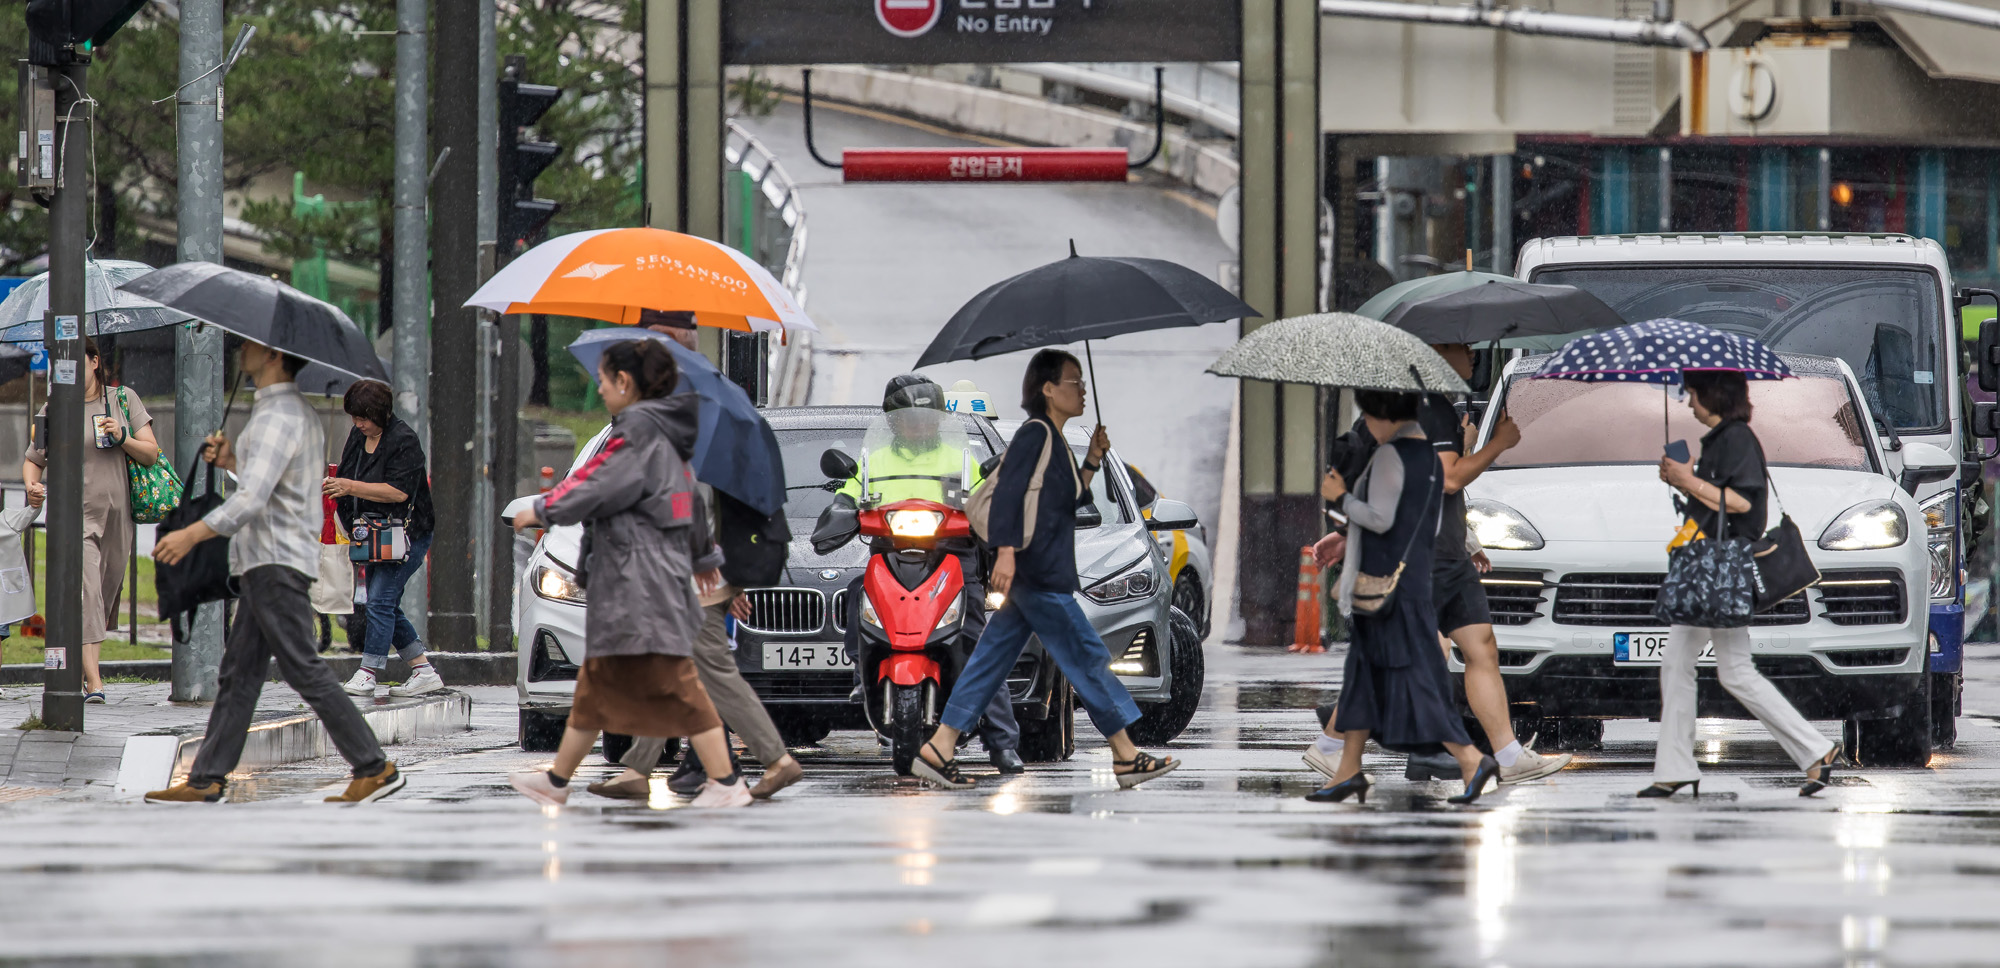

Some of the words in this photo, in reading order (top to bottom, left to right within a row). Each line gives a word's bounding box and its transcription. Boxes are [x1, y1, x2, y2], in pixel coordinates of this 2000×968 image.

[957, 16, 989, 32] No
[994, 15, 1053, 35] Entry
[948, 156, 1023, 178] 진입금지
[635, 254, 748, 290] SEOSANSOO
[776, 647, 815, 667] 14구
